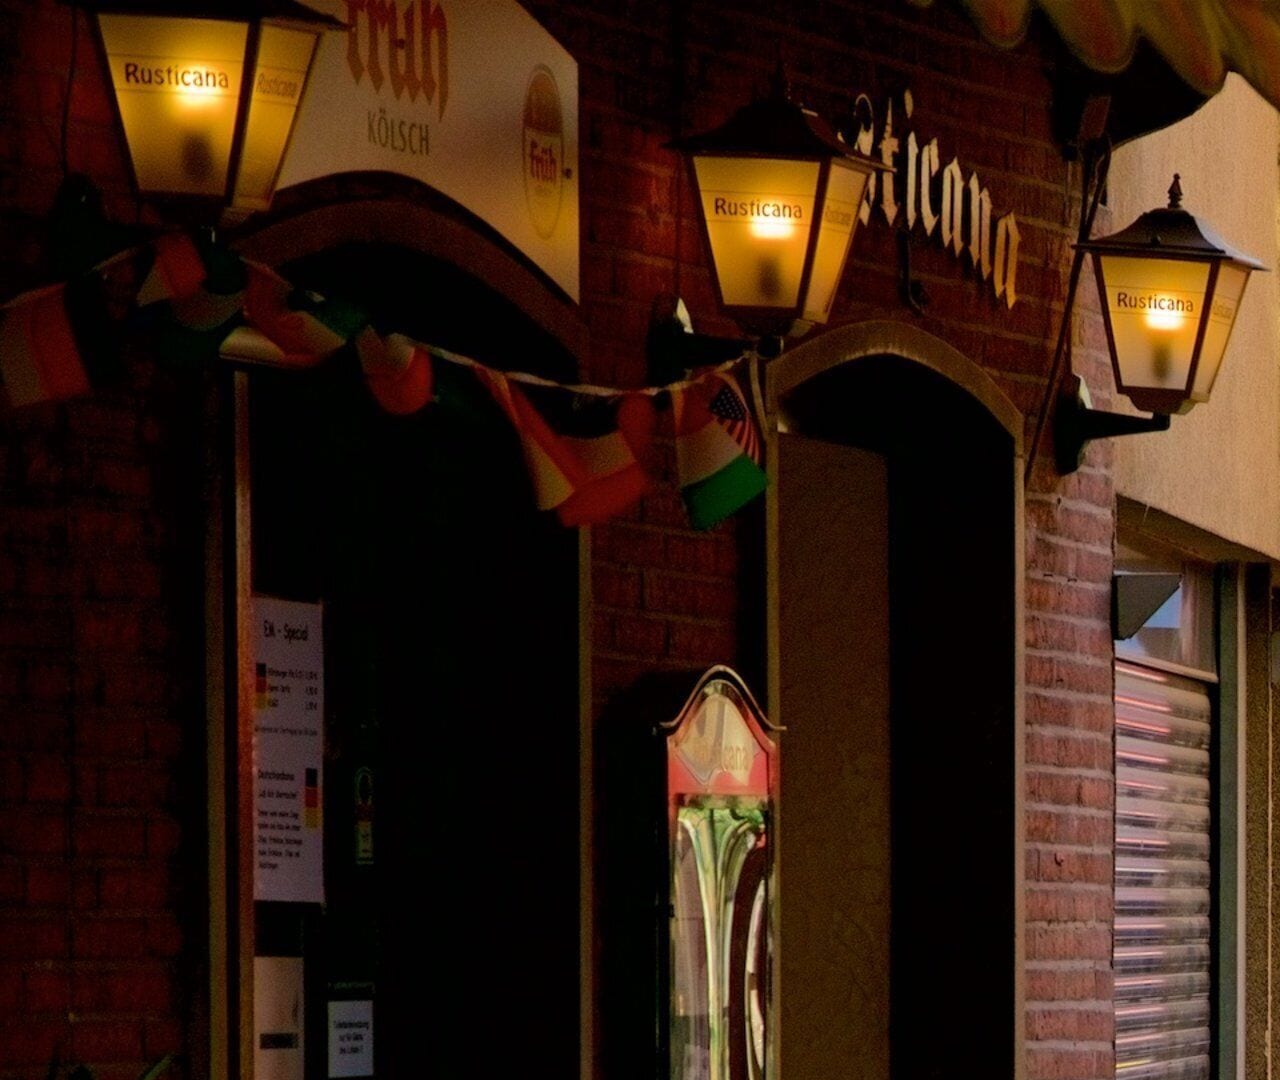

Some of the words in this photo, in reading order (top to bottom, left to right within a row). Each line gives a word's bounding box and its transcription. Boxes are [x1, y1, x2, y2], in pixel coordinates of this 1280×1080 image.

[124, 63, 230, 89] Rusticana
[367, 109, 430, 155] KÖLSCH
[714, 197, 803, 219] Rusticana
[1117, 292, 1194, 314] Rusticana
